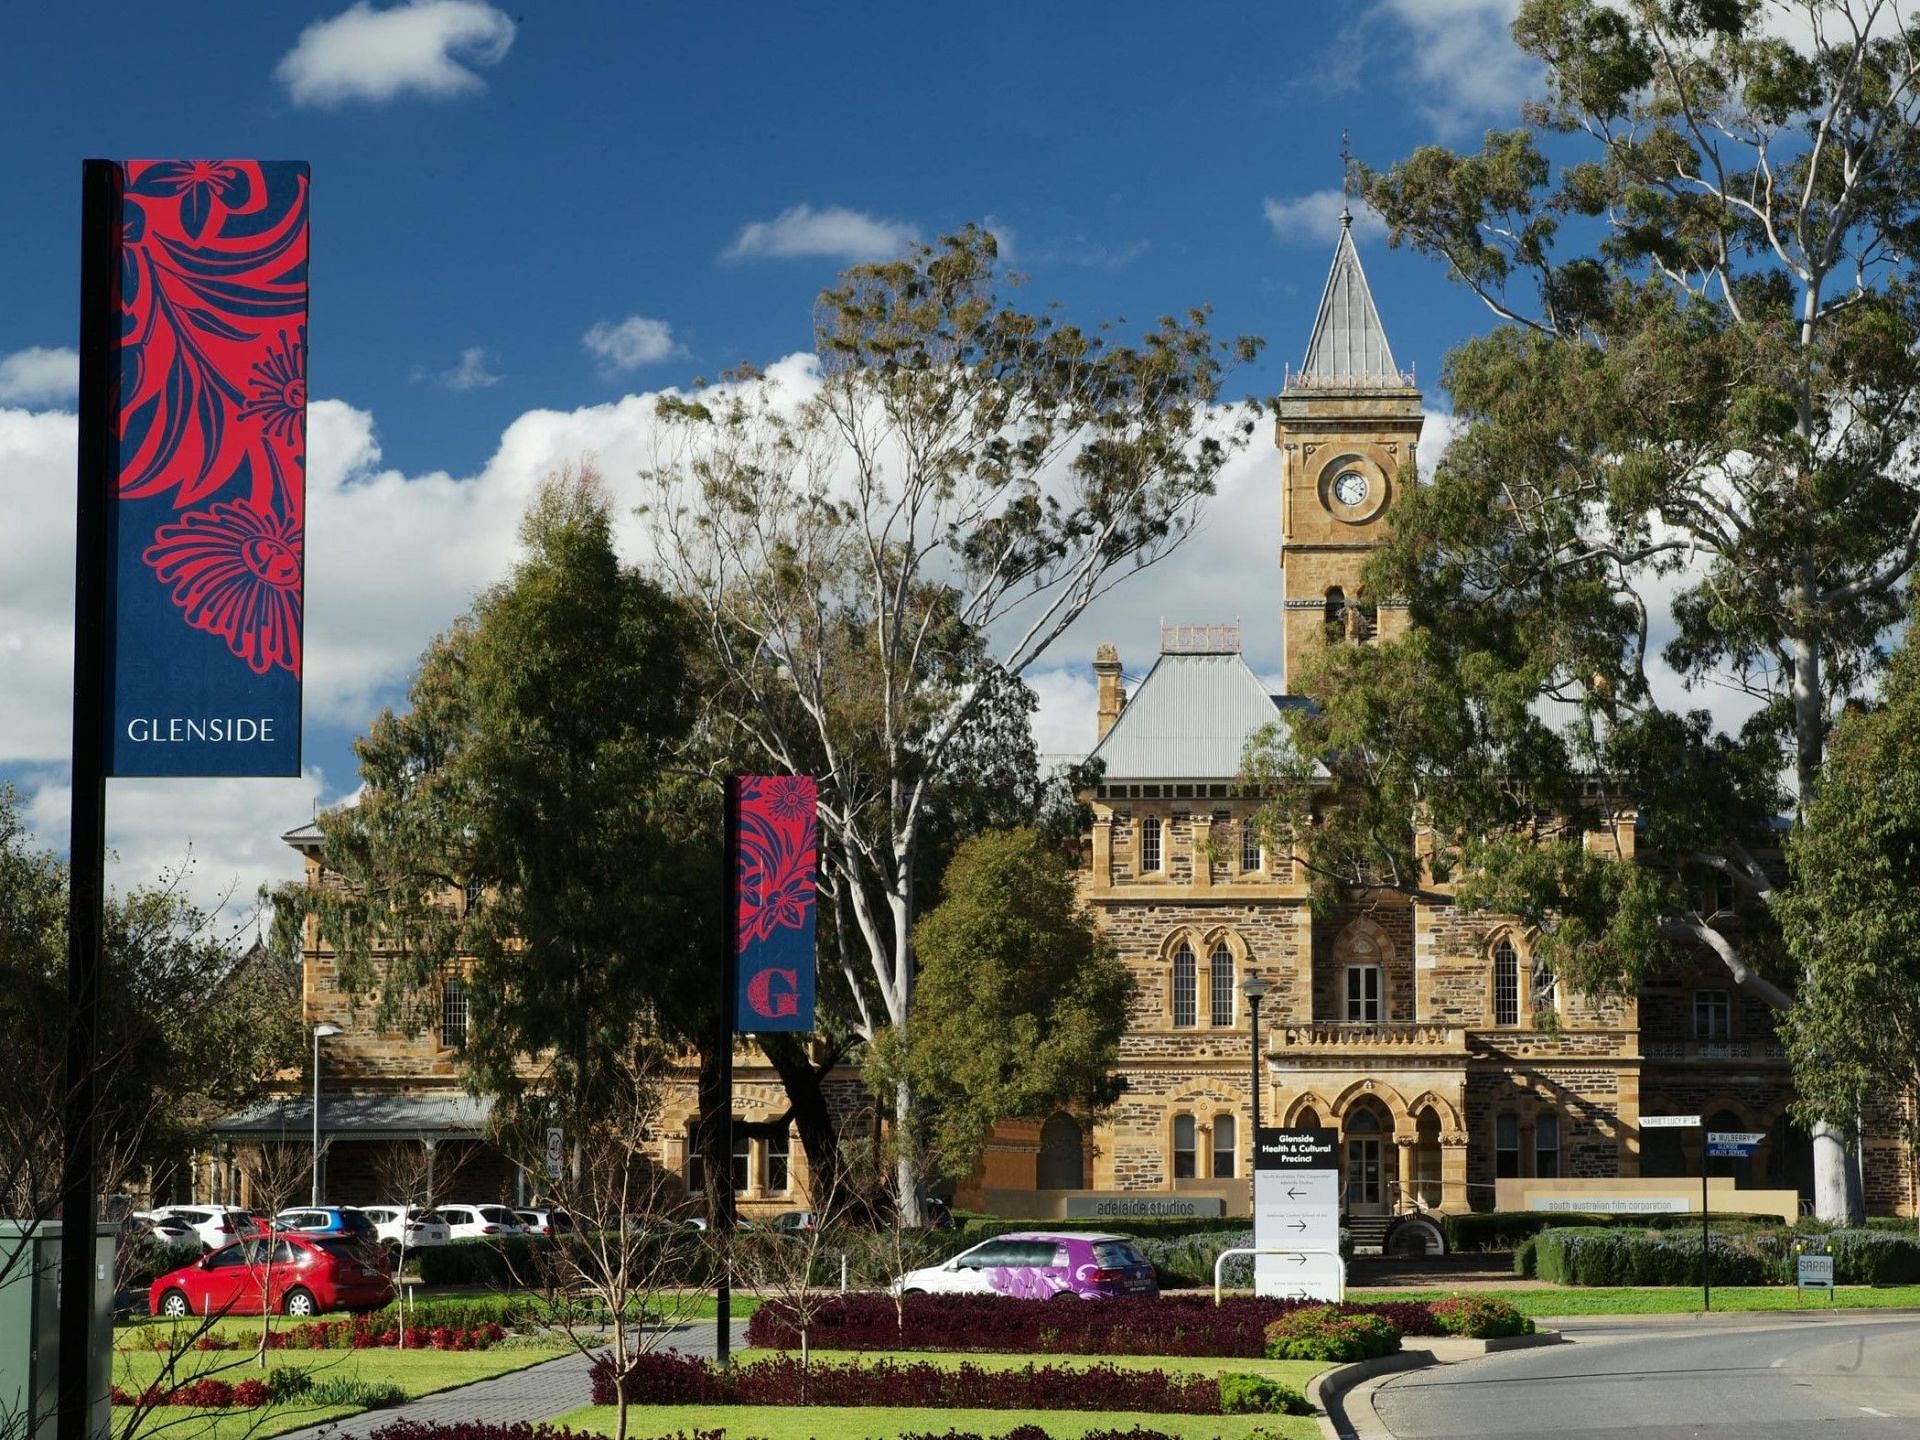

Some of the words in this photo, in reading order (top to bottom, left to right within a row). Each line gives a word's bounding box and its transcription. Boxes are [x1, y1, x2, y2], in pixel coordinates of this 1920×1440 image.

[127, 718, 275, 742] GLENSIDE
[747, 967, 800, 1018] G
[1279, 1135, 1315, 1143] Glenside
[1262, 1144, 1289, 1153] Health
[1290, 1145, 1298, 1153] &
[1299, 1144, 1332, 1153] Cultural
[1281, 1154, 1313, 1163] Precinct
[1097, 1200, 1146, 1216] adelaide
[1149, 1200, 1194, 1216] studios
[1548, 1201, 1571, 1210] south
[1573, 1201, 1609, 1210] australian
[1611, 1201, 1626, 1210] film
[1628, 1201, 1672, 1212] corporation
[1800, 1260, 1832, 1273] SARAH
